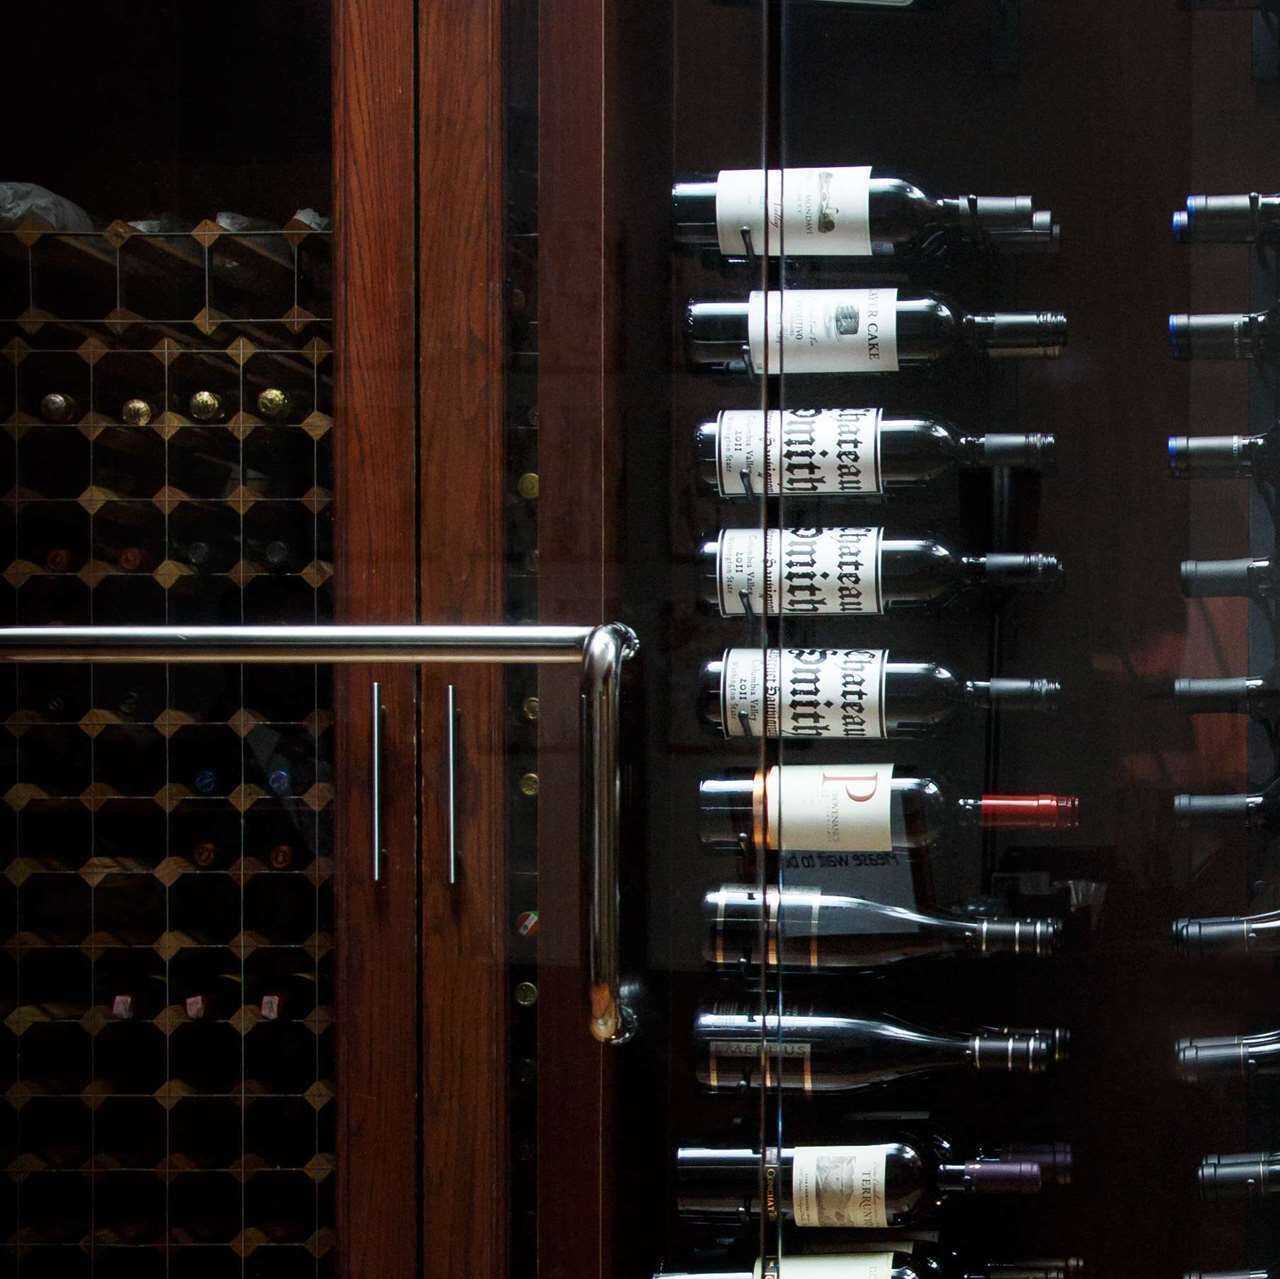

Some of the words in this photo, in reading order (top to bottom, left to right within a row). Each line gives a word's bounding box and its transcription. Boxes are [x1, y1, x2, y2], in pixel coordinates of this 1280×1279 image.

[866, 321, 880, 361] CAKE
[733, 431, 743, 453] 2011
[835, 409, 870, 491] hateau
[734, 551, 743, 574] 2011
[835, 527, 871, 613] hateau
[737, 676, 748, 701] 2011
